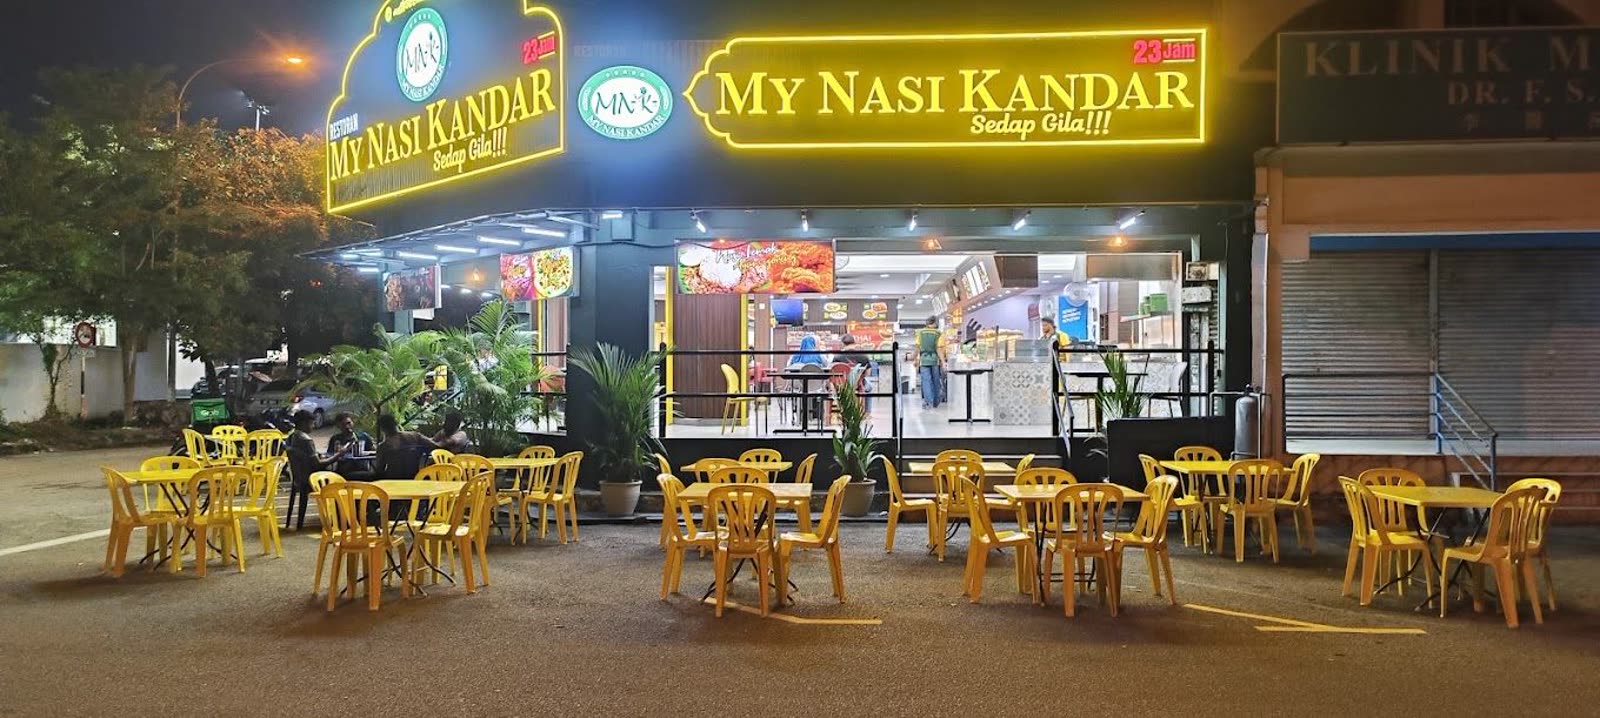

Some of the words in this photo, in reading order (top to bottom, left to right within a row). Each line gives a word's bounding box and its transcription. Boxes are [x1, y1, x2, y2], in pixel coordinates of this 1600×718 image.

[523, 38, 538, 64] 23
[1133, 39, 1162, 64] 23
[1162, 40, 1196, 59] Jam
[1305, 37, 1511, 77] KLINIK
[715, 71, 805, 115] MY
[818, 70, 945, 115] NASI
[958, 68, 1195, 113] KANDAR
[1448, 79, 1510, 105] DR.
[330, 135, 363, 182] MY
[366, 115, 422, 169] NASI
[426, 68, 556, 151] KANDAR
[330, 112, 359, 141] RESTORAN
[970, 112, 1036, 141] Sedap
[1041, 110, 1113, 136] Gila!!!
[433, 144, 467, 173] Sedap
[468, 126, 508, 162] Gila!!!
